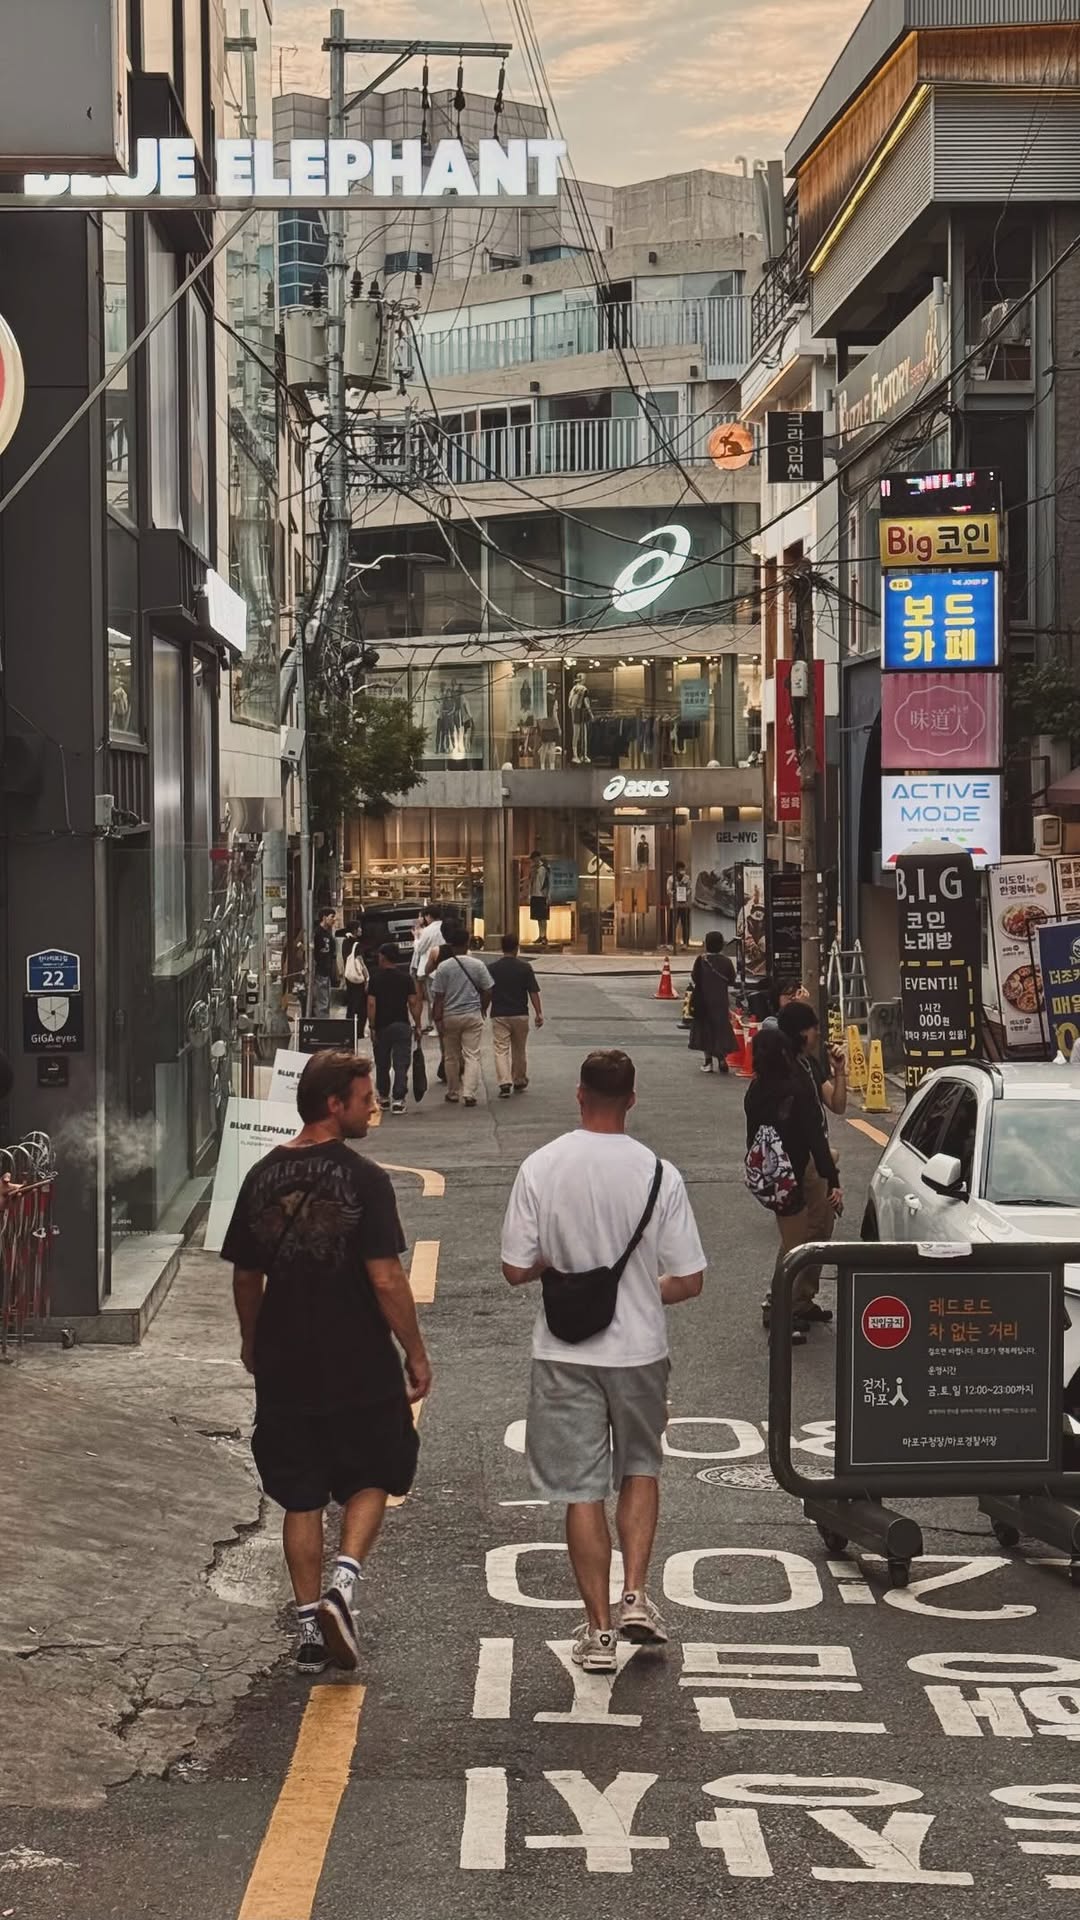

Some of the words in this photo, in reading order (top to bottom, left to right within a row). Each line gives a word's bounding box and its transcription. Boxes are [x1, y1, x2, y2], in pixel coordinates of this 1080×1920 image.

[217, 138, 567, 196] ELEPHANT
[786, 412, 804, 480] 크라임씬
[887, 526, 933, 562] Big
[936, 523, 990, 555] 코인
[903, 593, 976, 627] 보드
[903, 629, 976, 662] 카페
[910, 707, 968, 736] 味道人
[892, 783, 991, 799] ACTIVE
[901, 806, 981, 822] MODE
[716, 832, 758, 843] GEL-NYC
[896, 867, 963, 904] B.I.G
[907, 911, 946, 929] 코인
[904, 932, 952, 950] 노래방
[42, 971, 65, 986] 22
[904, 976, 958, 991] EVENT!!
[55, 1035, 77, 1045] eyes
[277, 1069, 295, 1078] BLUE
[230, 1121, 251, 1130] BLUE
[253, 1123, 297, 1135] ELEPHANT
[928, 1297, 993, 1316] 레드로드
[870, 1317, 904, 1328] 진입금지
[928, 1323, 945, 1342] 차
[950, 1322, 983, 1343] 없는
[988, 1320, 1018, 1341] 거리
[928, 1366, 957, 1375] 운영시간
[862, 1378, 890, 1393] 걷자,
[928, 1385, 961, 1397] 금.토.일
[864, 1393, 889, 1407] 마포
[902, 1436, 997, 1448] 마포구청장/마포경찰서장
